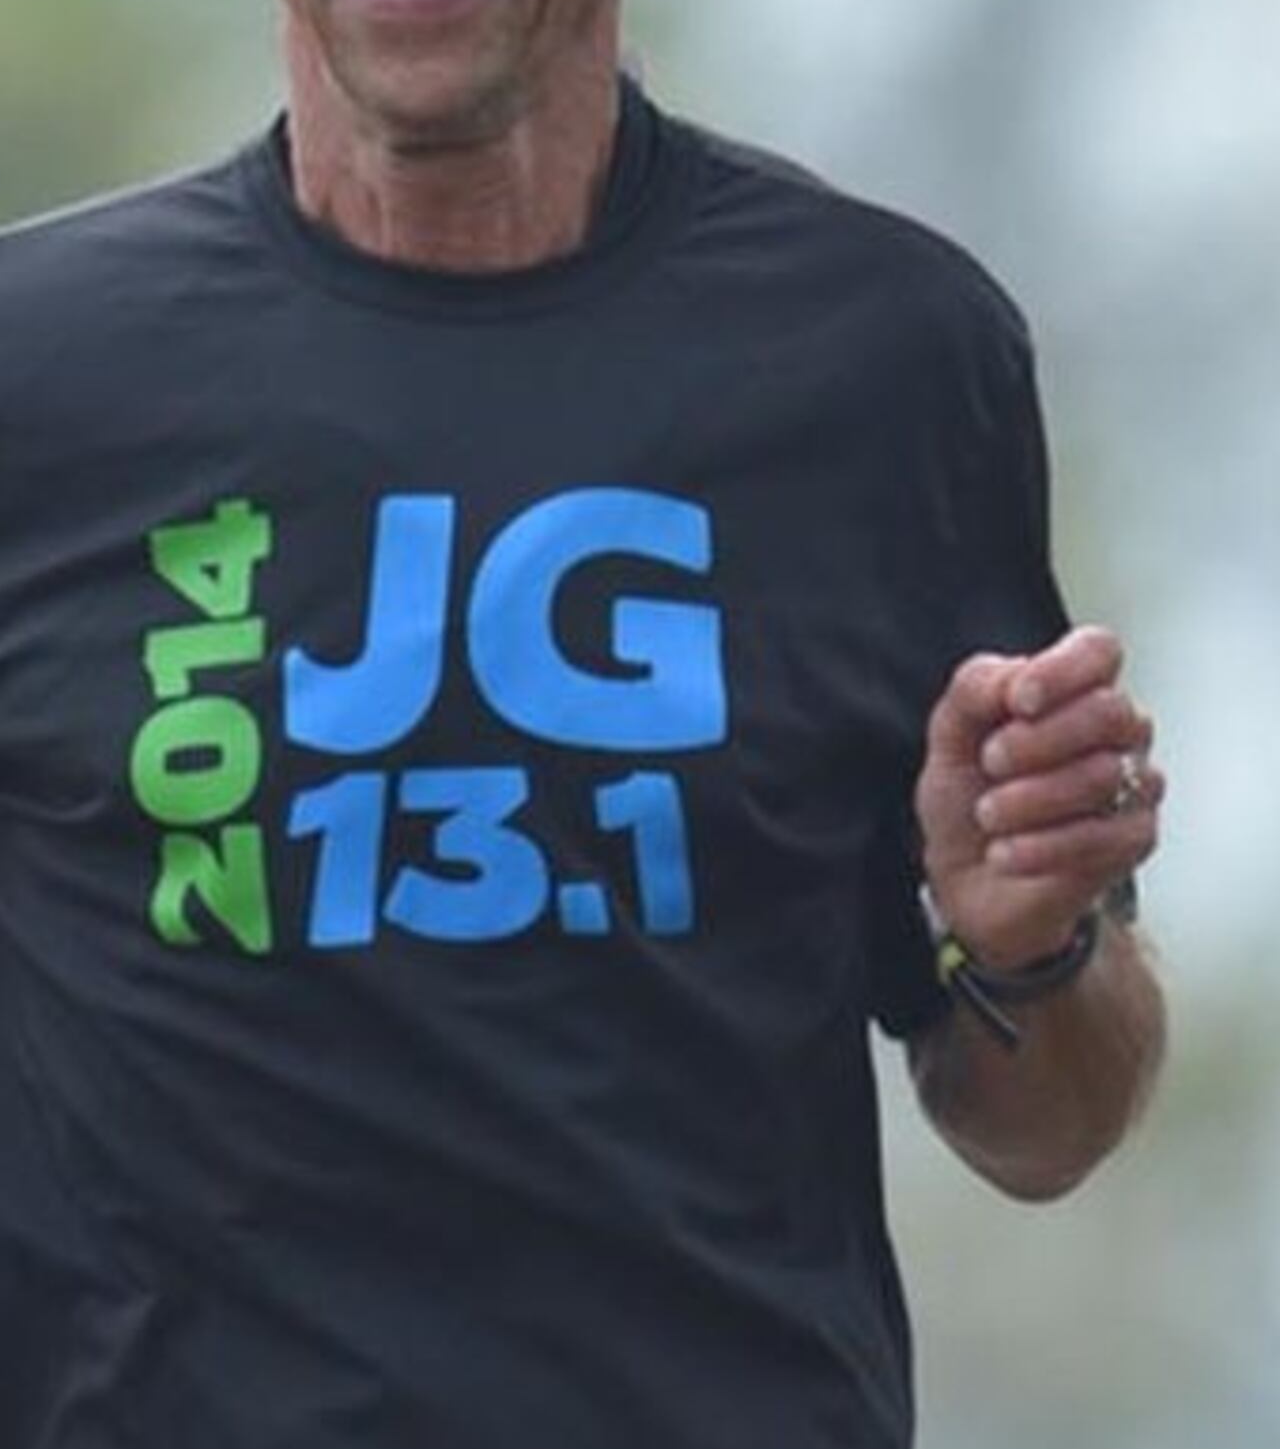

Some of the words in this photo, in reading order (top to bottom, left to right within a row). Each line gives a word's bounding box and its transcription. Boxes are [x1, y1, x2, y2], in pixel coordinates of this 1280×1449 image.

[131, 498, 272, 954] 2014
[282, 486, 727, 752] JG
[287, 765, 695, 948] 13.1
